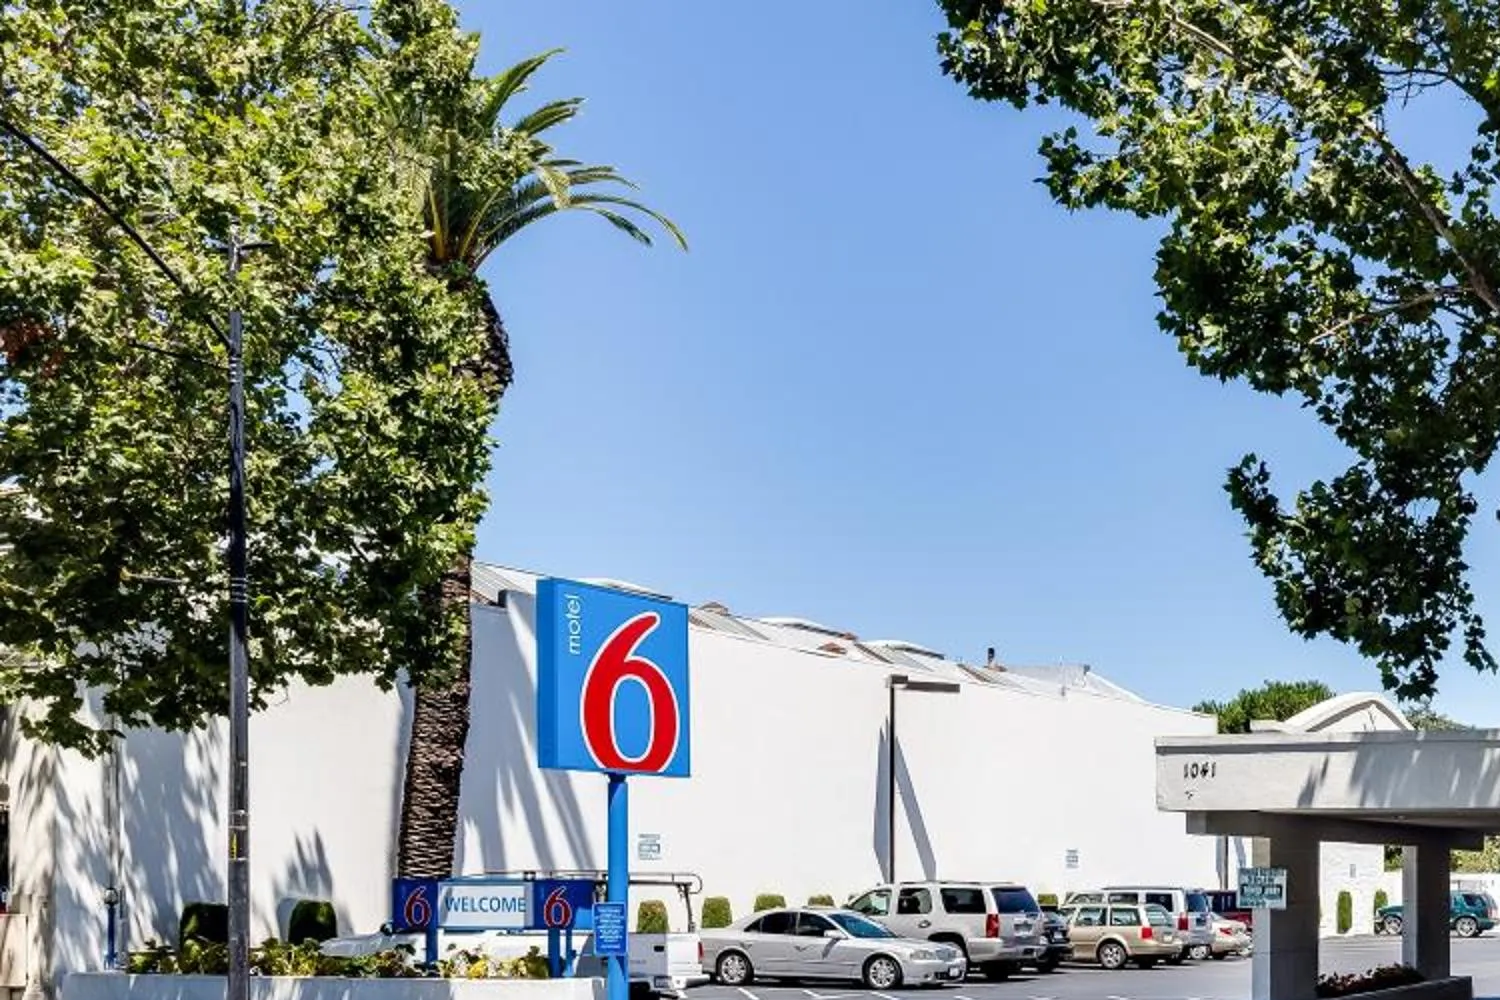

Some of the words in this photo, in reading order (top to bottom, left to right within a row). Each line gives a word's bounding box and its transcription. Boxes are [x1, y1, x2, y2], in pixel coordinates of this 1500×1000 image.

[564, 594, 582, 655] motel
[580, 611, 680, 772] 6
[1183, 761, 1216, 778] 1041
[404, 886, 431, 927] 6
[444, 896, 527, 912] WELCOME
[543, 886, 572, 927] 6
